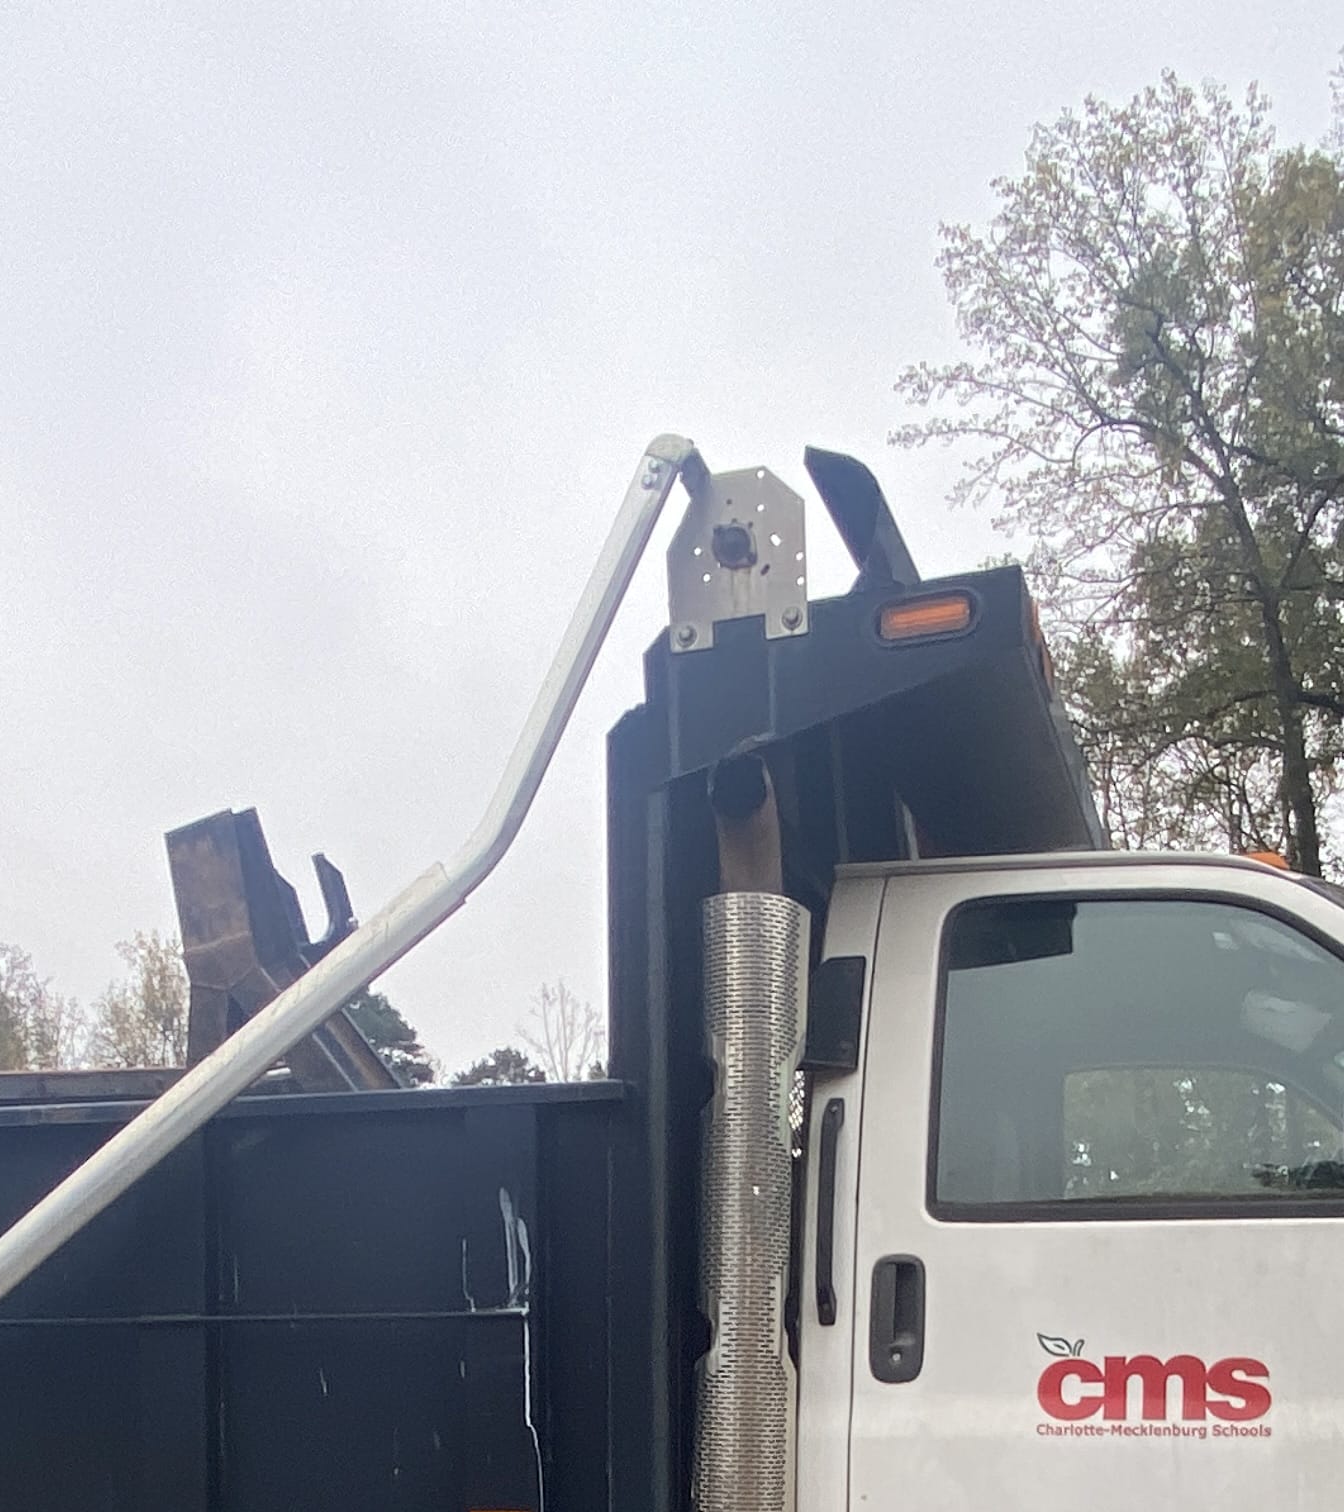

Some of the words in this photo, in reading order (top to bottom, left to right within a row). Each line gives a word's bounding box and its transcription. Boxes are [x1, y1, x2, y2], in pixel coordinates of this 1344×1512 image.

[1037, 1354, 1272, 1421] cms
[1036, 1424, 1207, 1438] Charlotte-Mecklenburg
[1212, 1424, 1272, 1437] Schools
